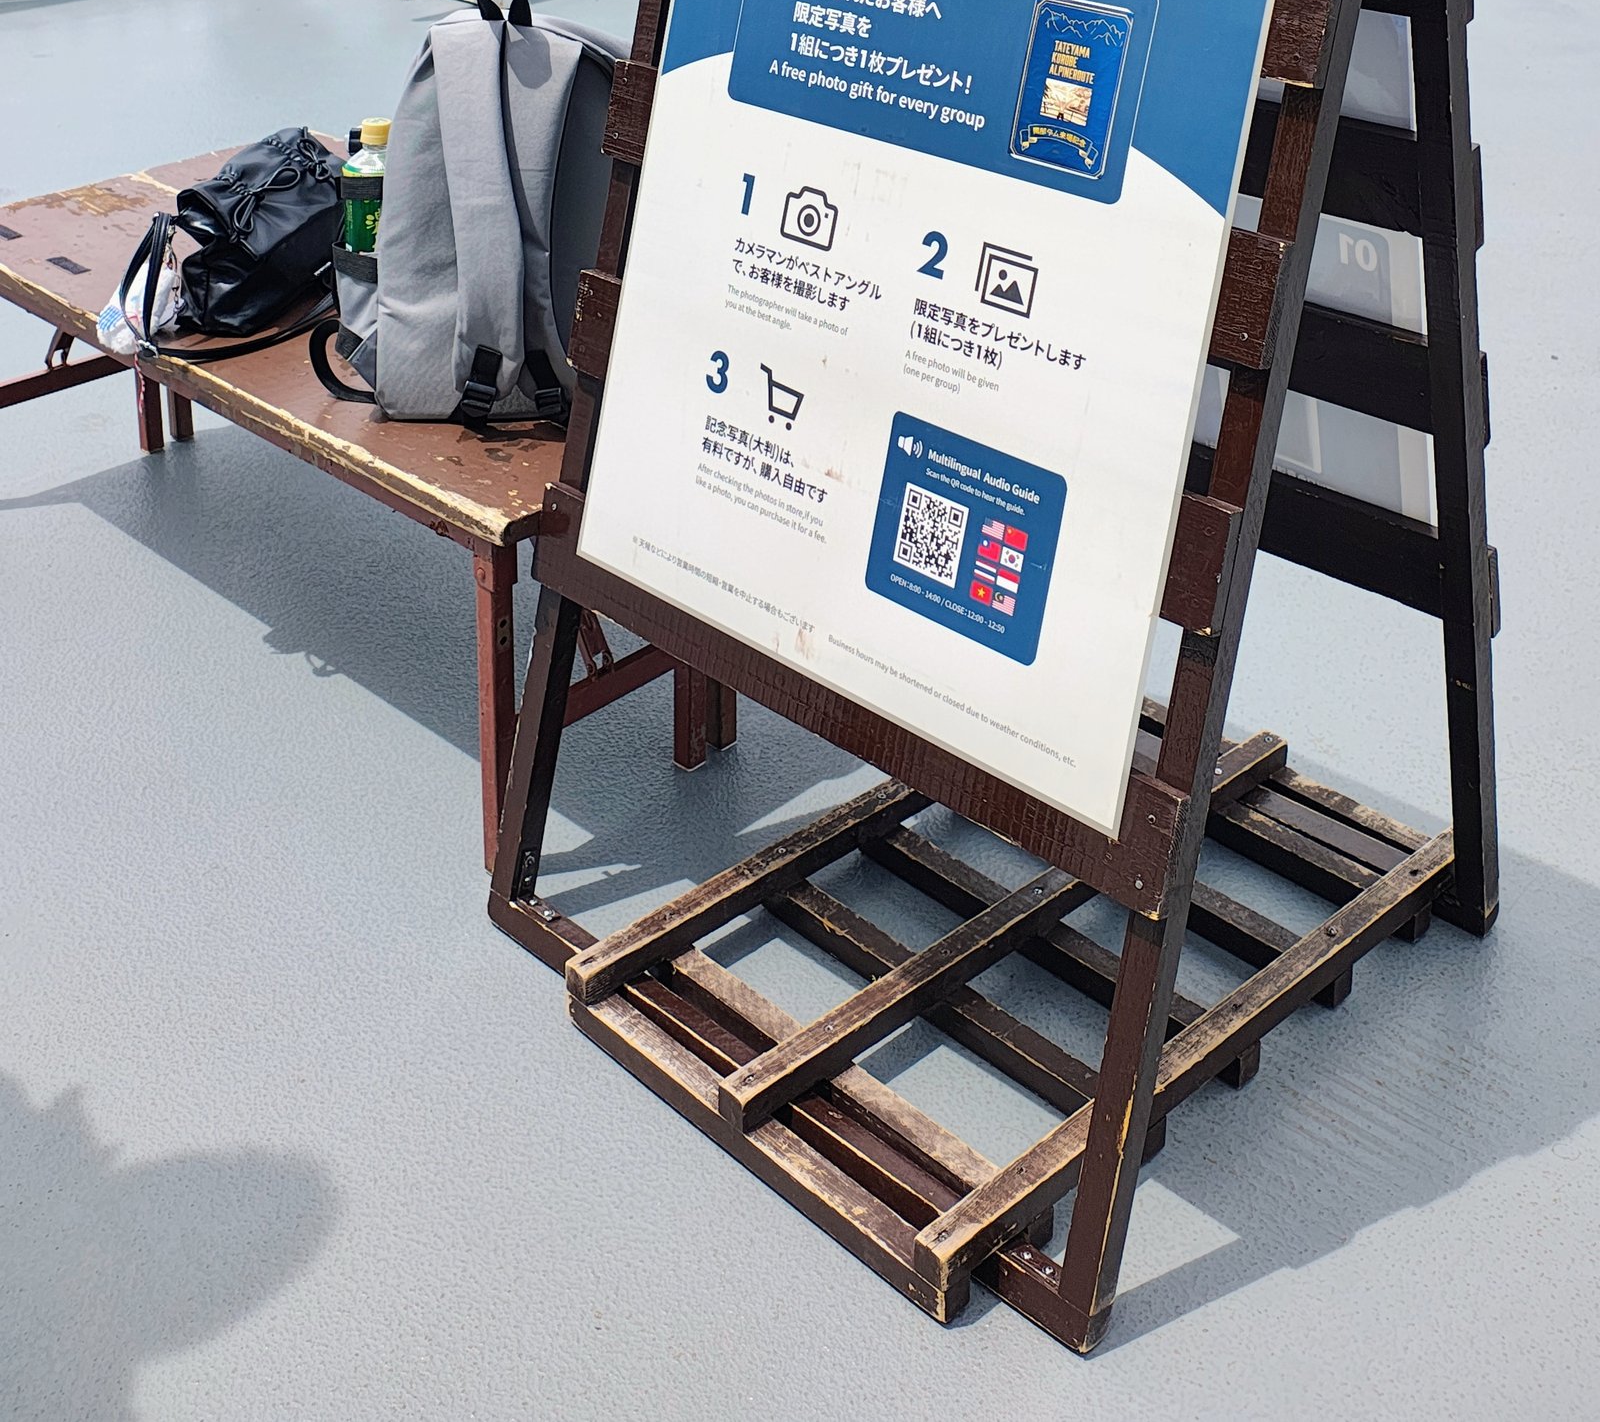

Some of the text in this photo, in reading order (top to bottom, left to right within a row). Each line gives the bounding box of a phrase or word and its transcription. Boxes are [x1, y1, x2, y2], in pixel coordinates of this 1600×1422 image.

[792, 1, 872, 38] 限定写真を
[790, 32, 973, 95] 1組につき1枚プレゼント!
[1049, 64, 1095, 85] ALPINEROUTE
[1051, 51, 1079, 68] KUROBE
[1054, 40, 1091, 59] TATEYAMA
[769, 59, 986, 131] A free photo gift for every group
[741, 172, 756, 216] 1
[734, 237, 882, 301] カメラマンがベストアングル
[916, 230, 949, 280] 2
[732, 258, 850, 311] で、お客様を撮影します
[725, 299, 793, 331] you at the best angle.
[727, 284, 740, 296] The
[740, 287, 785, 313] photographer
[784, 303, 797, 317] will
[798, 309, 813, 324] take
[819, 319, 839, 334] photo
[840, 327, 849, 336] of
[913, 298, 1087, 370] 限定写真をプレゼントします
[910, 320, 1003, 371] (1組につき1枚)
[706, 350, 730, 394] 3
[903, 363, 961, 394] (one per group)
[905, 350, 999, 392] A free photo will be given
[701, 436, 828, 504] 有料ですが、購入自由です
[925, 468, 1025, 516] Scan the QR code to hear the guide.
[928, 449, 1040, 504] Multilingual Audio Guide
[698, 463, 713, 475] After
[713, 466, 742, 491] checking
[743, 482, 754, 495] the
[754, 488, 777, 505] photos
[778, 497, 785, 508] in
[810, 514, 823, 528] you
[712, 483, 733, 502] photo,
[734, 494, 746, 507] you
[747, 500, 759, 513] can
[759, 505, 790, 529] purchase
[791, 519, 797, 529] it
[798, 522, 808, 534] for
[814, 530, 827, 544] fee.
[925, 590, 941, 604] 14:00
[988, 620, 1005, 634] 12:50
[828, 634, 1077, 768] Business hours may be shortened or closed due to weather conditions, etc.
